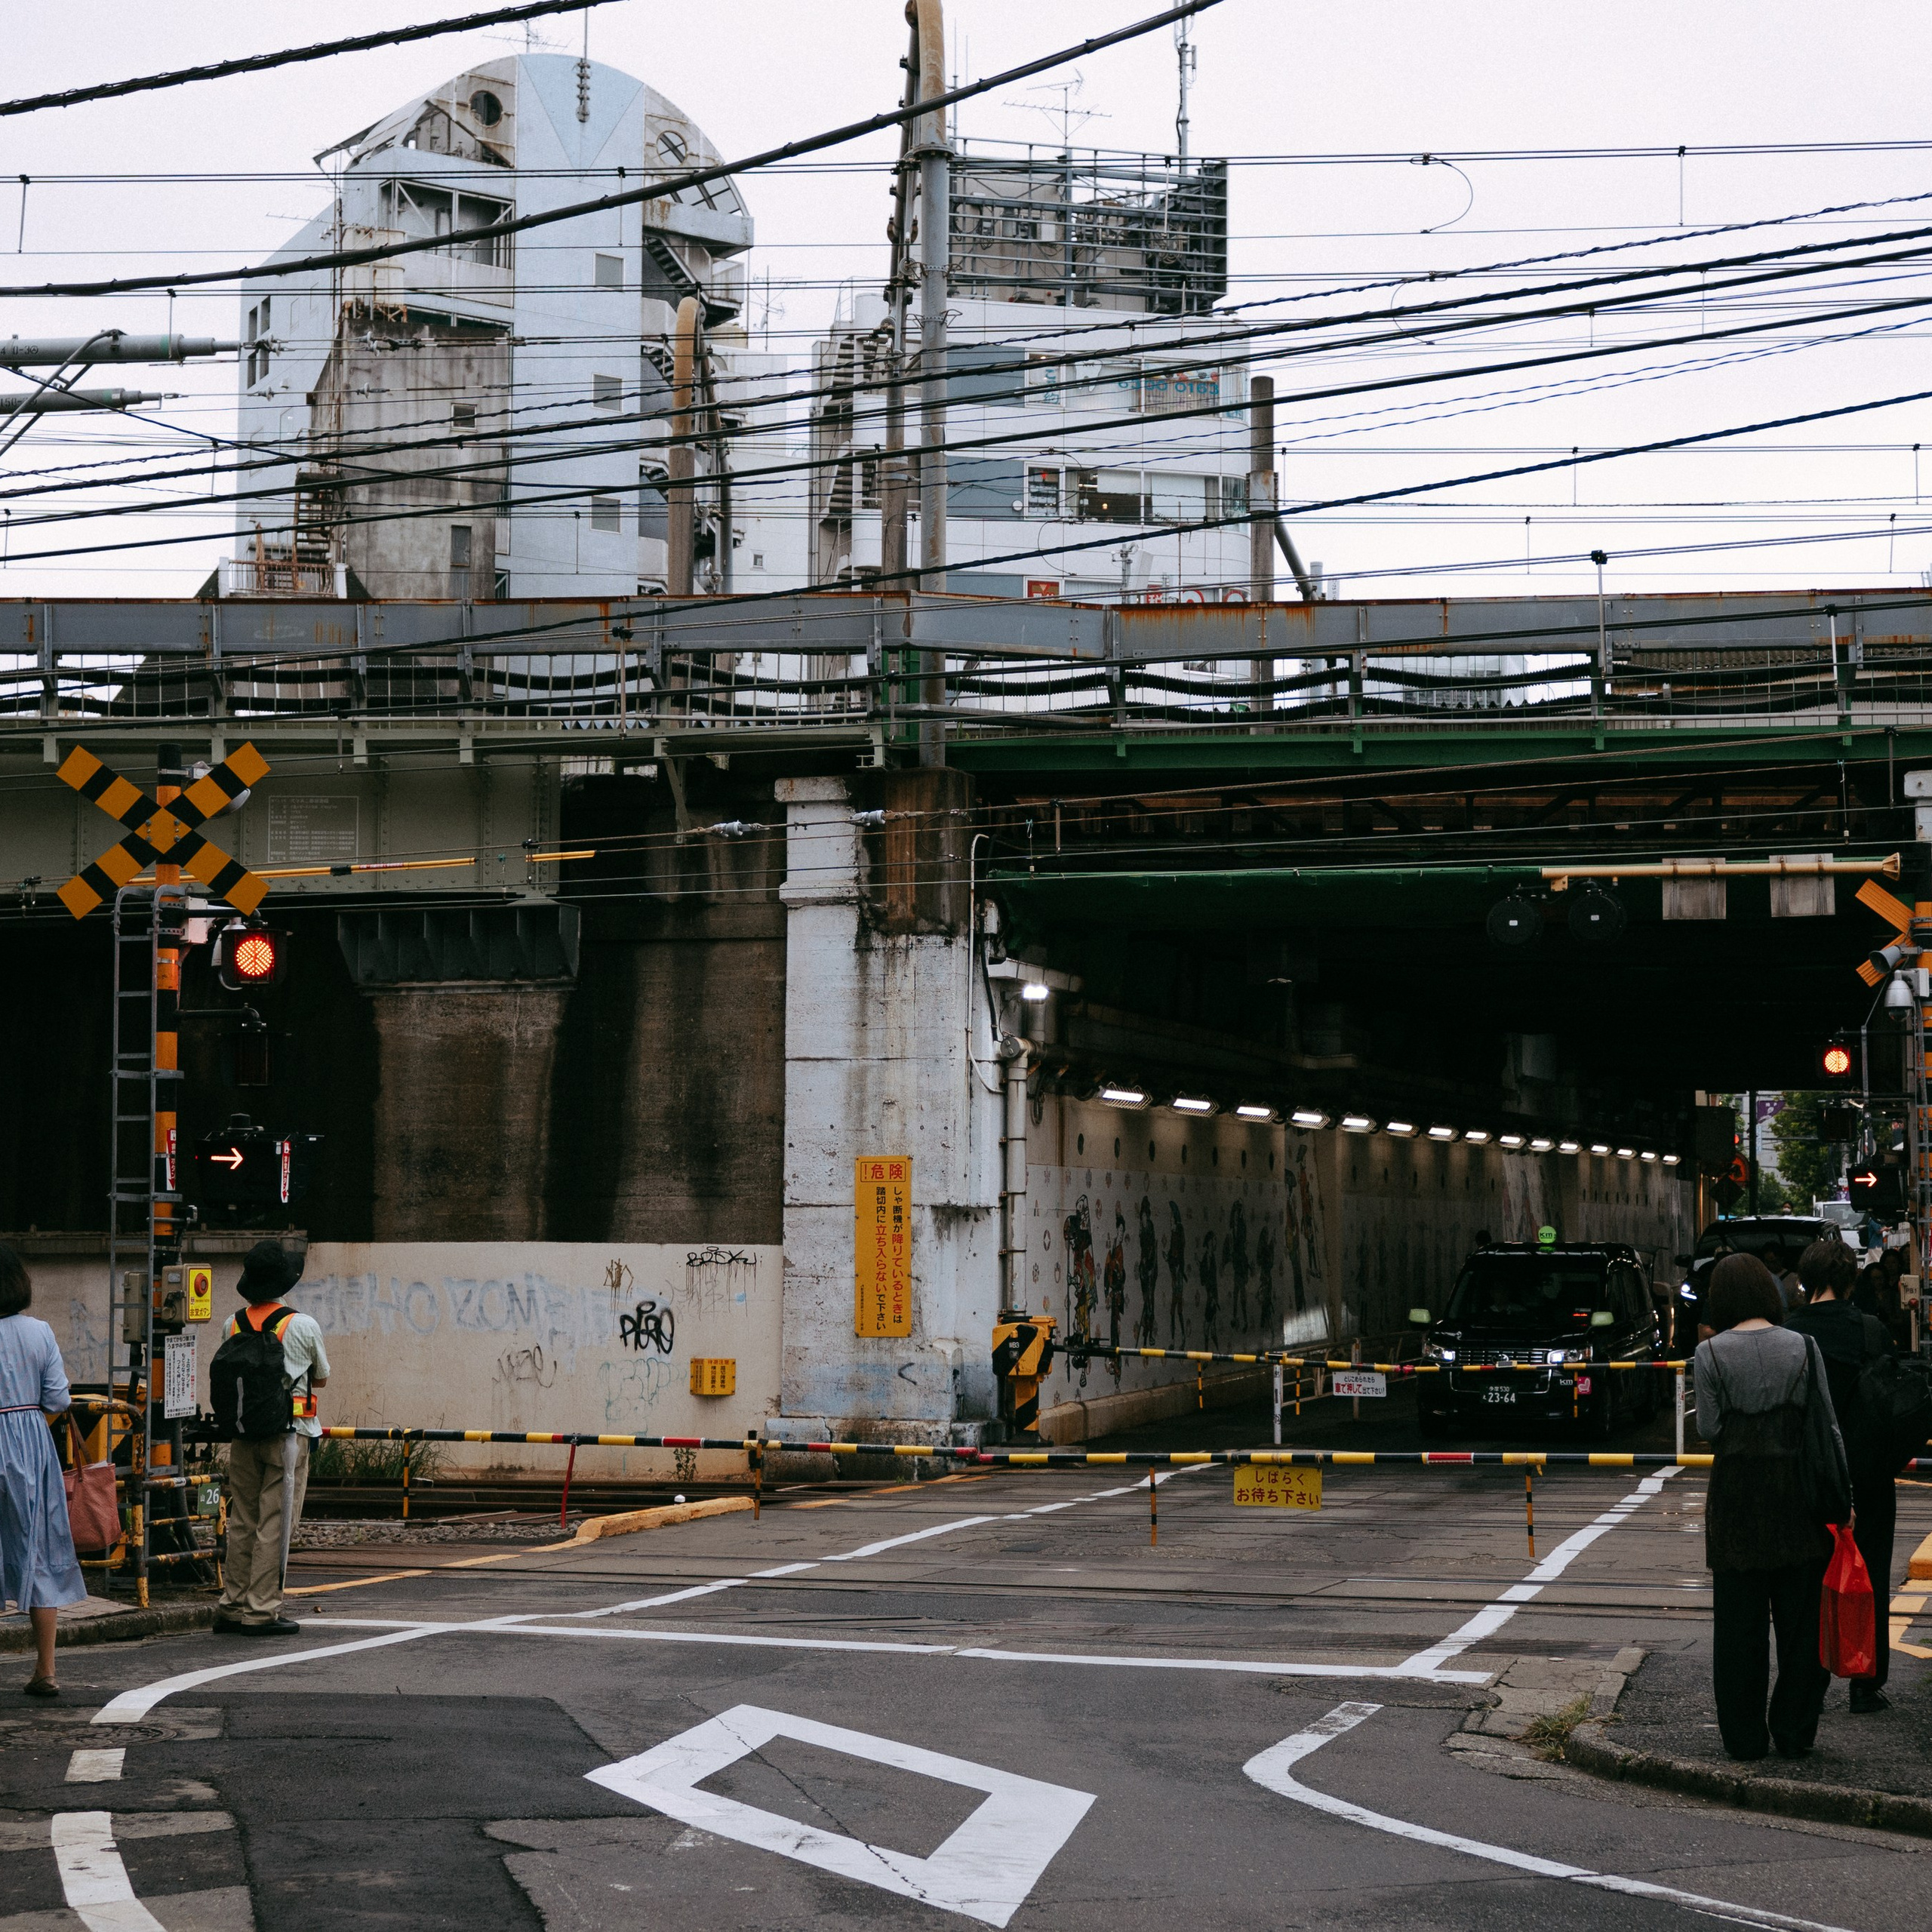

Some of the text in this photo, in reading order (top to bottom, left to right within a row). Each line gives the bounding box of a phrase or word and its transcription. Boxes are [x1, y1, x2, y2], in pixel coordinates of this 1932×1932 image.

[1175, 382, 1220, 395] 0163
[871, 1164, 903, 1180] 危険
[875, 1186, 888, 1331] 踏切内に立ち入らないで下さい
[892, 1186, 904, 1324] しゃ断機が降りているときは
[1488, 1392, 1515, 1403] 23-64
[1255, 1470, 1304, 1485] しばらく
[206, 1487, 220, 1505] 26
[1236, 1487, 1319, 1506] お待ち下さい
